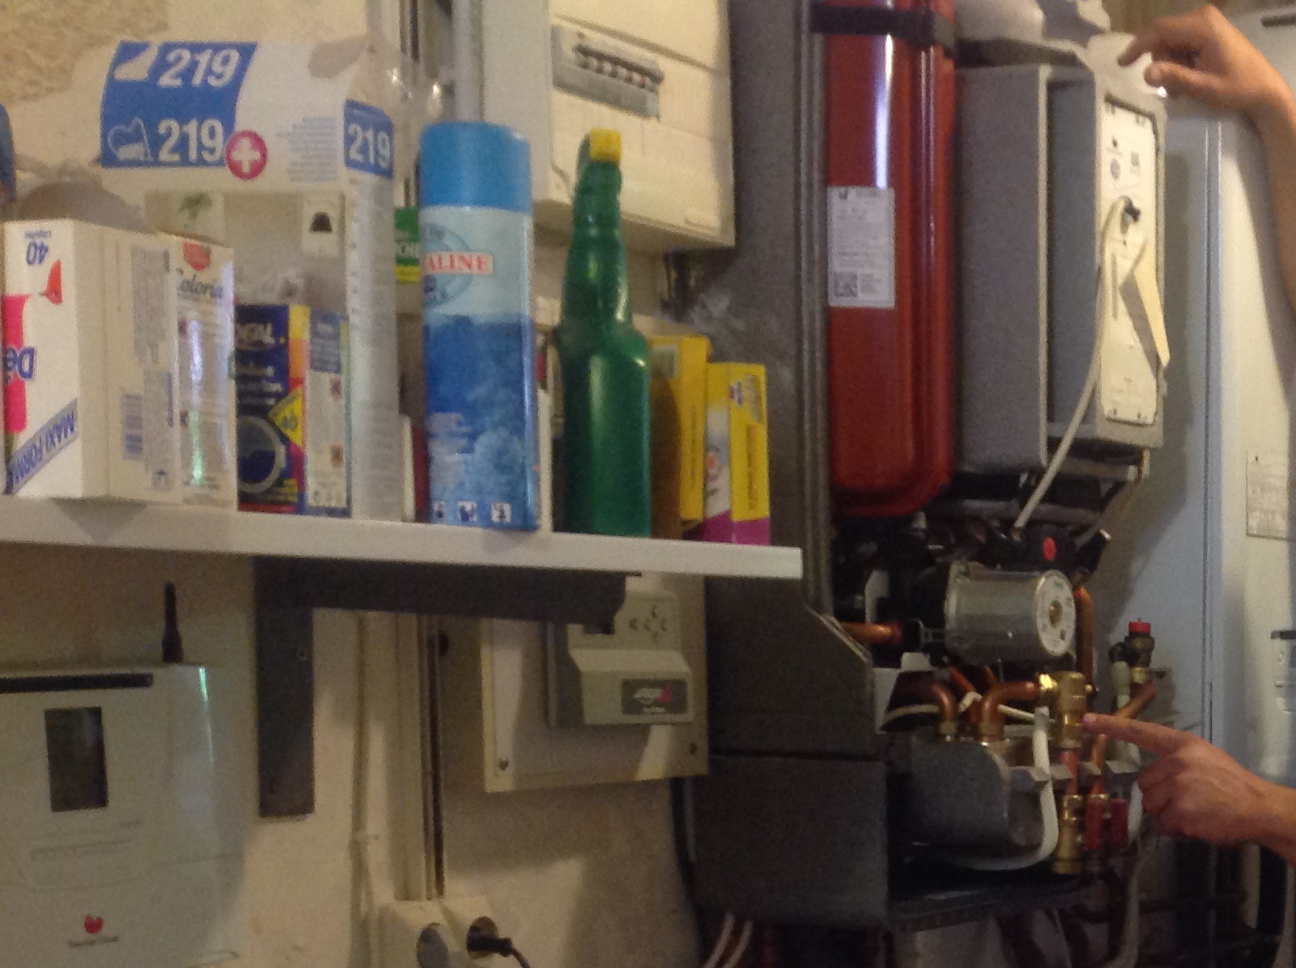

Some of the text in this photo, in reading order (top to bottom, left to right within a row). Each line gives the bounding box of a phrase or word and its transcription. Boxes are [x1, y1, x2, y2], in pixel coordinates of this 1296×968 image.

[157, 48, 241, 88] 219
[157, 118, 224, 163] 219
[347, 123, 391, 169] 219
